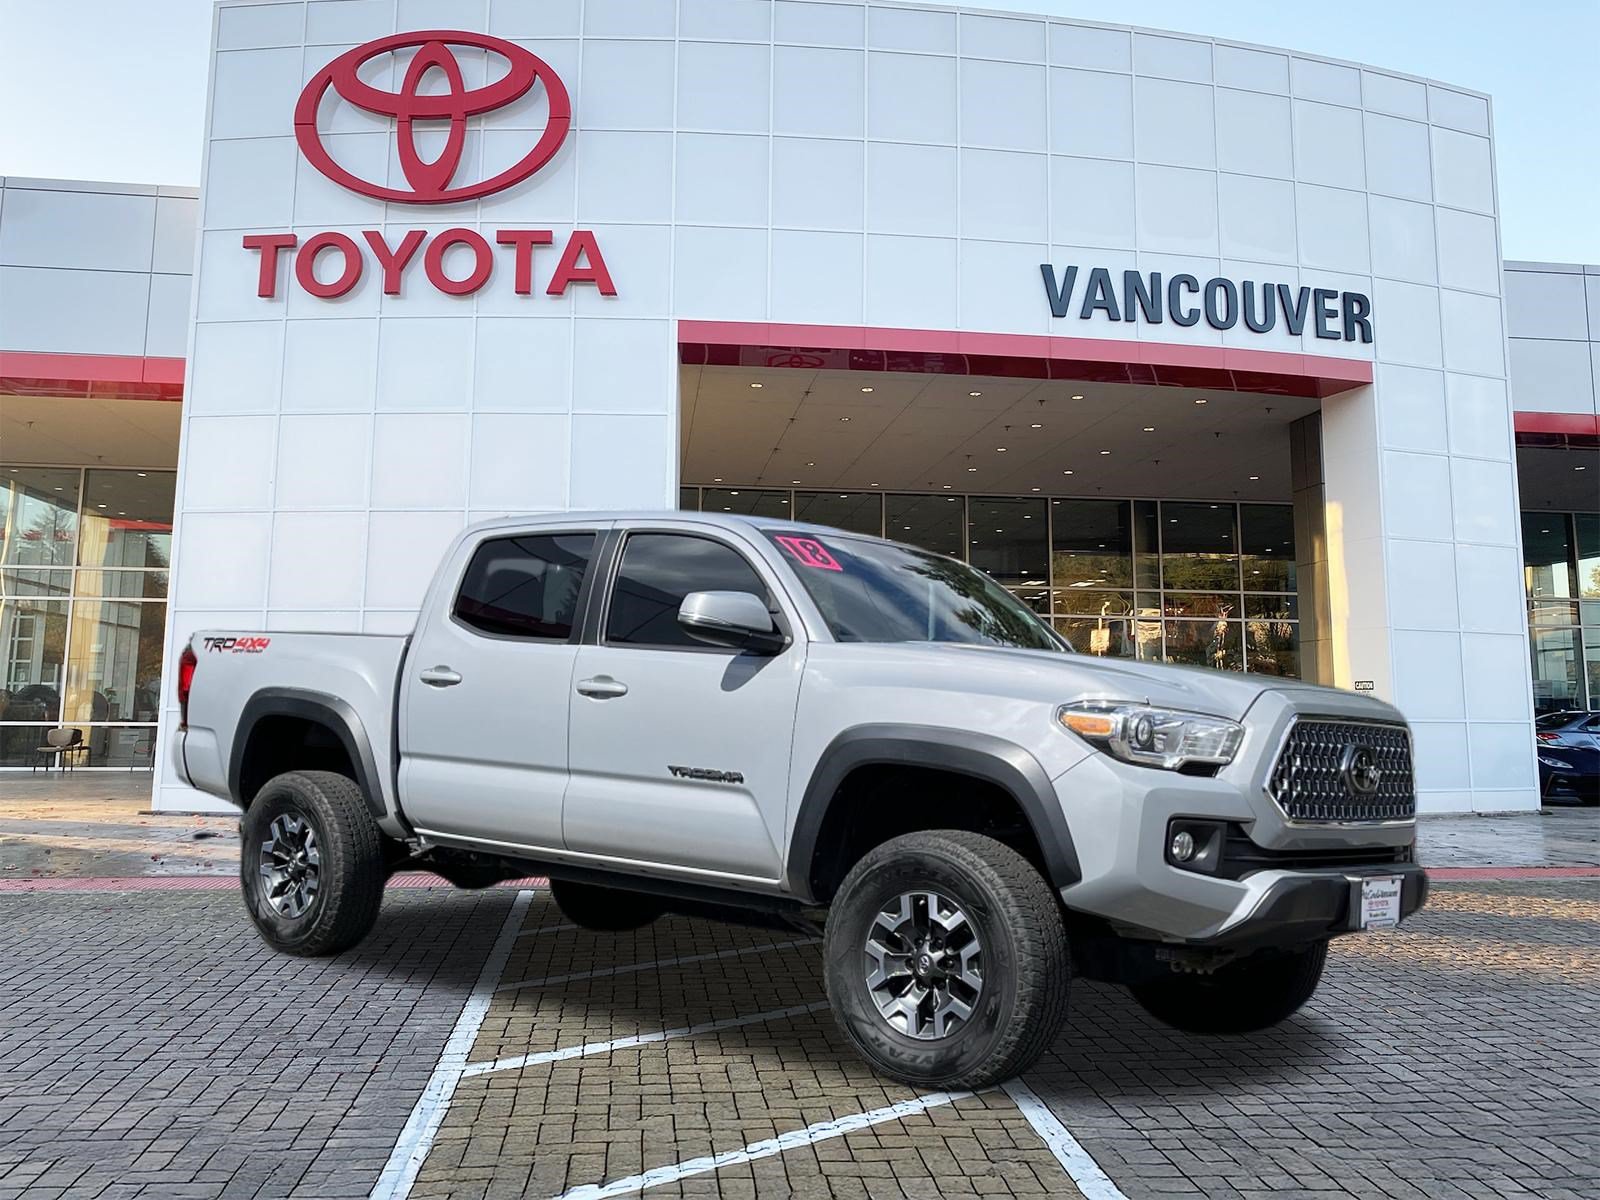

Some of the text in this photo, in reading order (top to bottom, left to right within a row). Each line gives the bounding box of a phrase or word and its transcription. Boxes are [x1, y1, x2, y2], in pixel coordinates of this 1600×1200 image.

[243, 228, 618, 298] TOYOTA
[1040, 264, 1373, 343] VANCOUVER
[783, 540, 831, 565] 18
[667, 765, 744, 784] TACOMA
